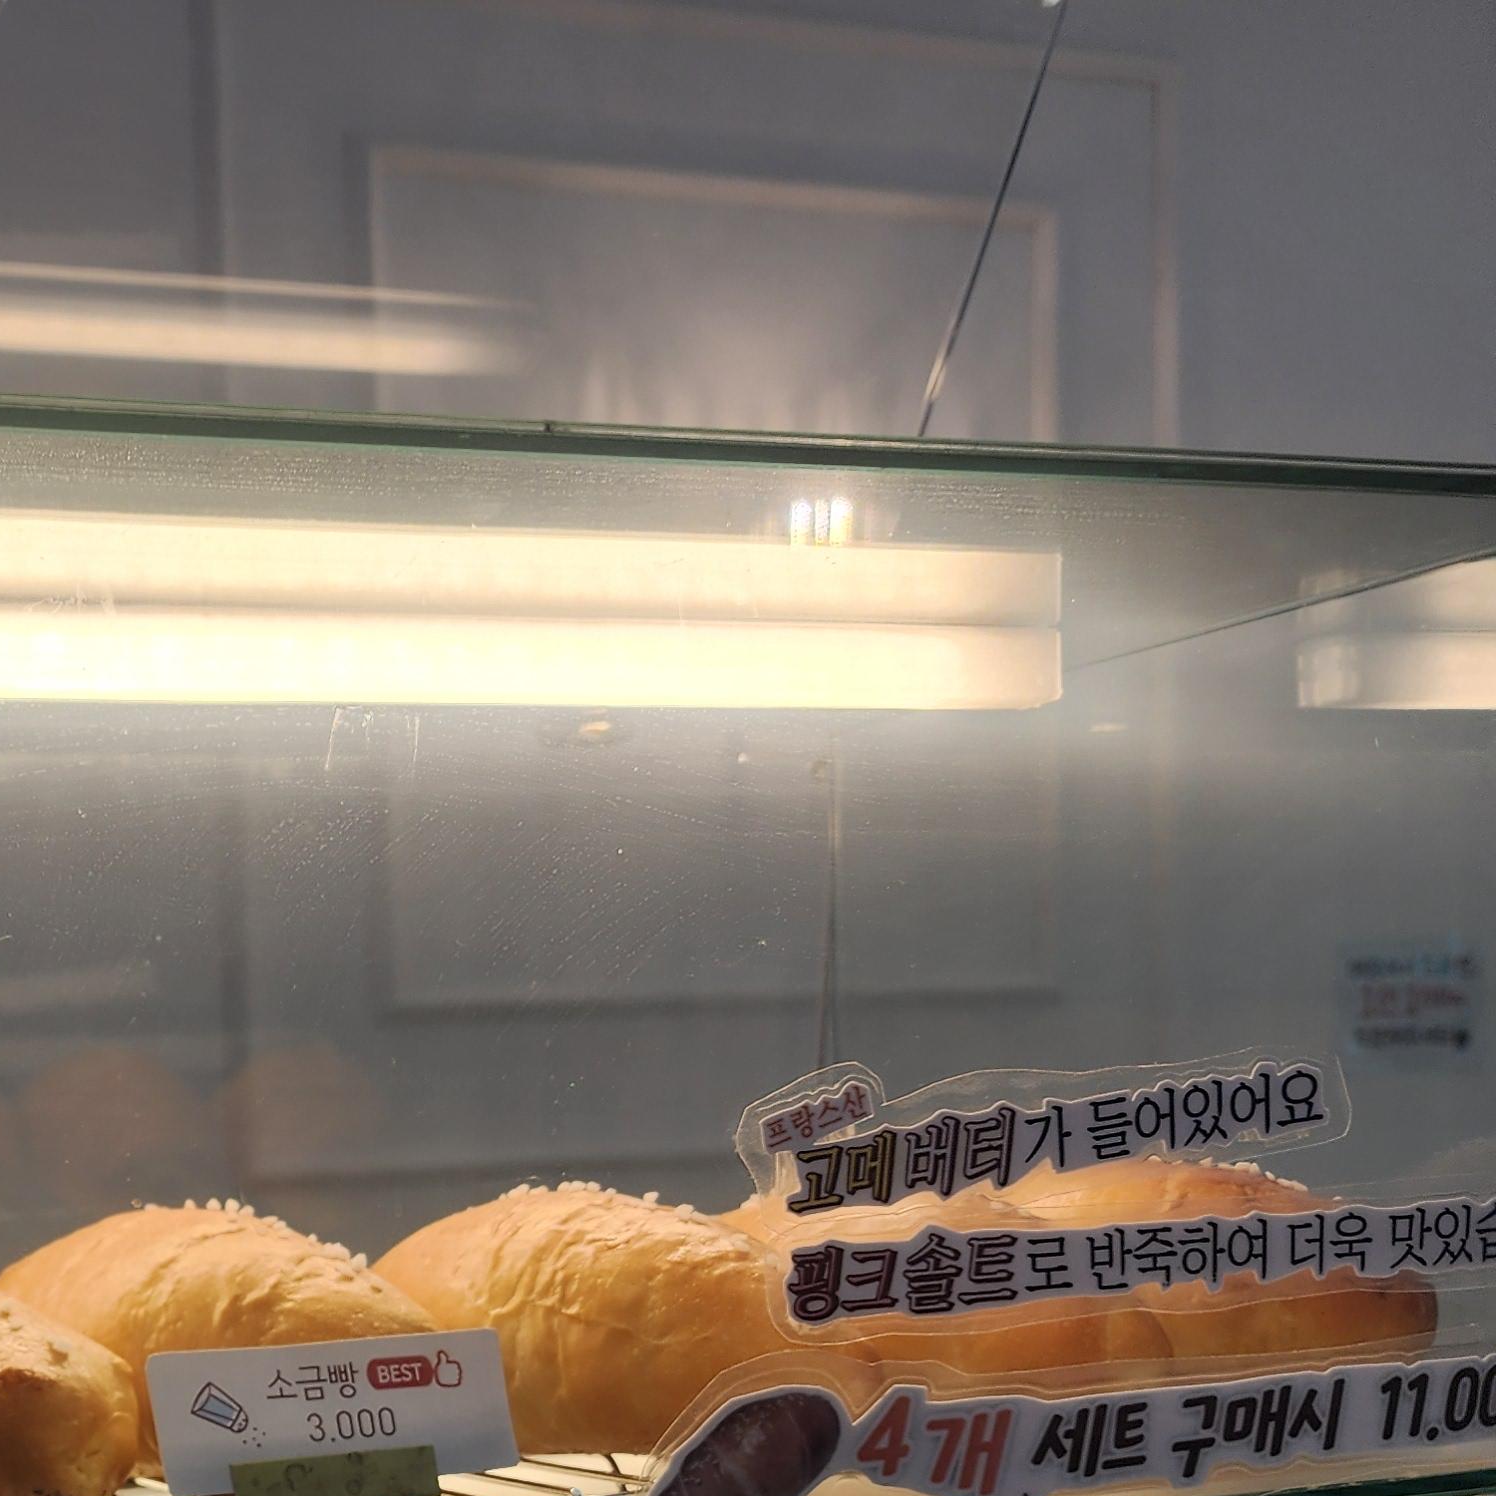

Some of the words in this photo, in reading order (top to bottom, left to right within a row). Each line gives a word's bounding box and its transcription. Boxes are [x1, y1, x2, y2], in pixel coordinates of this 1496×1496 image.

[765, 1085, 872, 1149] 프랑스산
[787, 1105, 1072, 1214] 고메버터가
[1086, 1069, 1325, 1161] 들어있어요
[787, 1231, 1076, 1324] 핑크솔트로
[1089, 1217, 1268, 1288] 반죽하여
[1286, 1212, 1373, 1275] 더욱
[266, 1361, 360, 1401] 소금빵
[376, 1361, 426, 1384] BEST
[306, 1406, 397, 1443] 3.000
[857, 1392, 1015, 1496] 4개
[1031, 1399, 1148, 1479] 세트
[1171, 1379, 1346, 1480] 구매시
